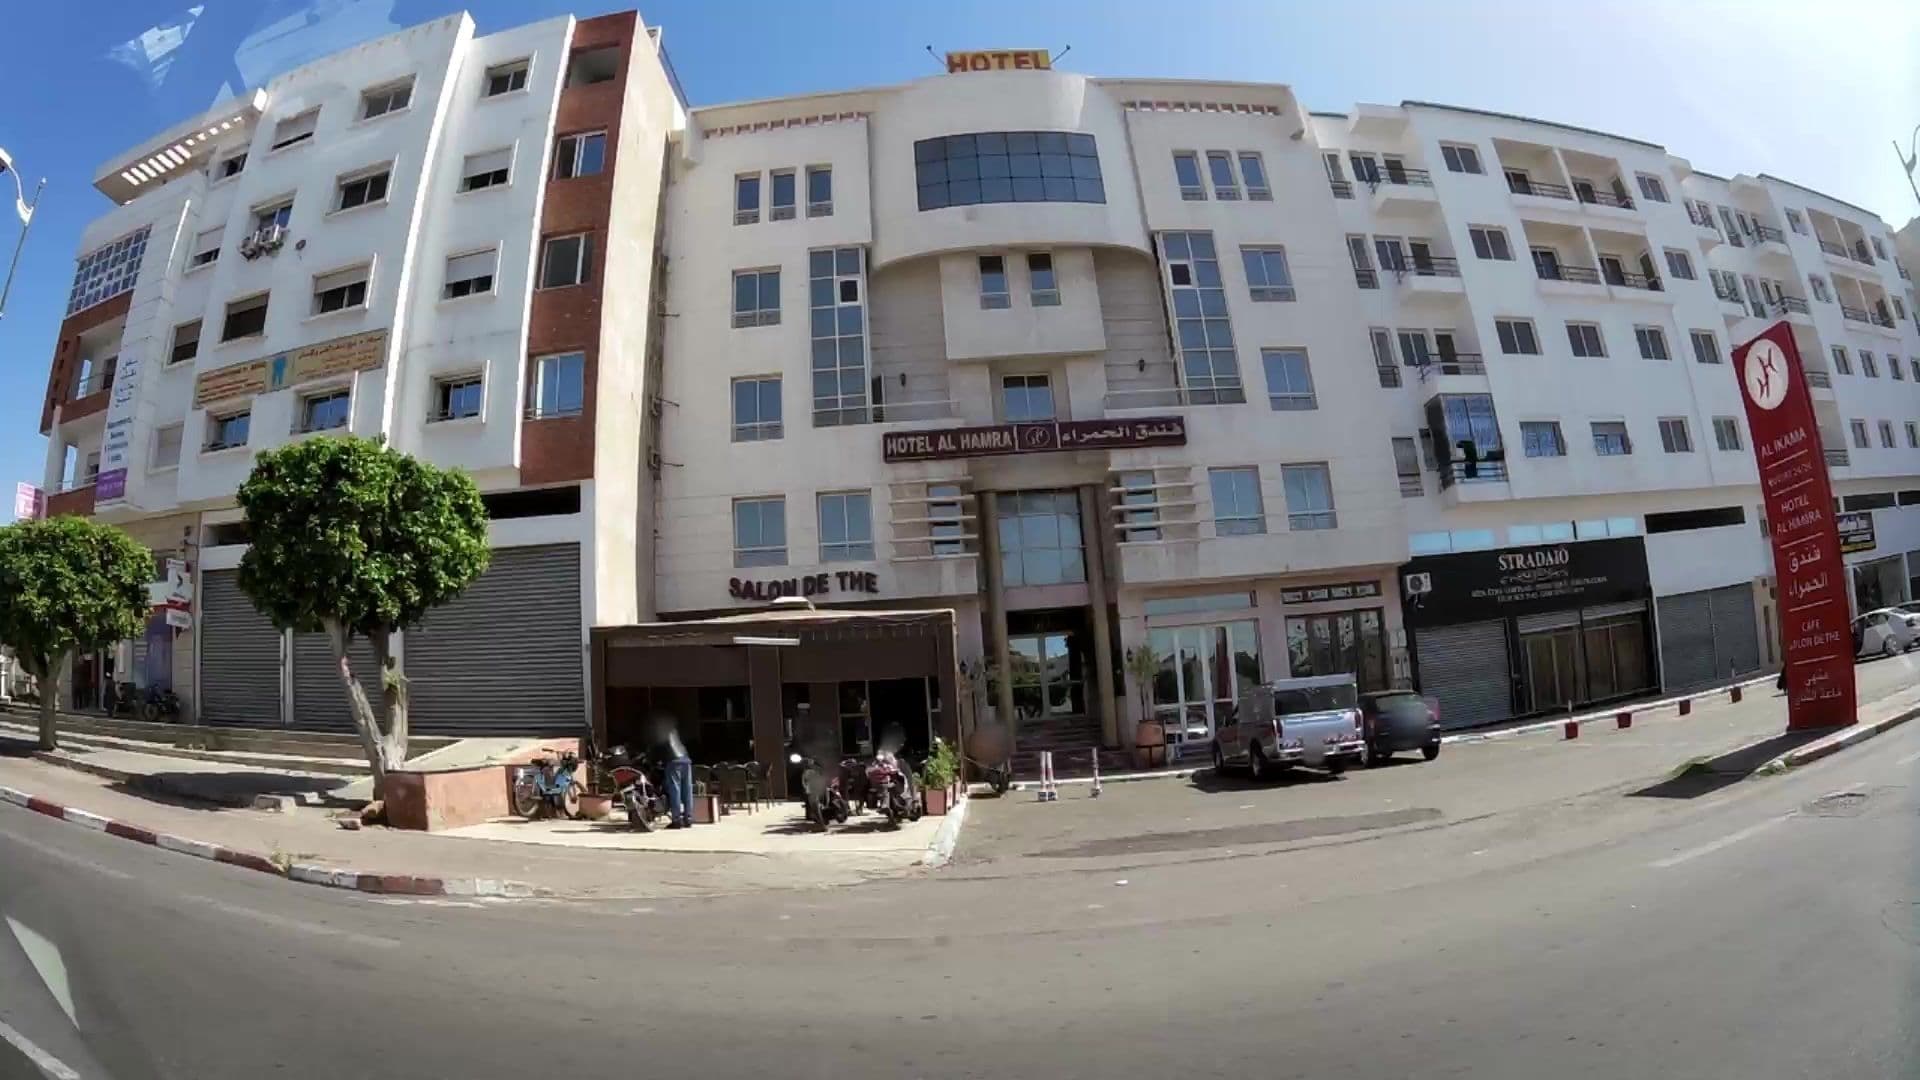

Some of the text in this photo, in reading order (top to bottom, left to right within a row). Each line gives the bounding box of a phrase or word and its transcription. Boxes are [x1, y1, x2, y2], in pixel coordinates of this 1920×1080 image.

[946, 51, 1052, 73] HOTEL
[886, 432, 1013, 455] HOTEL AL HAMRA
[1062, 421, 1184, 443] فندق الحمراء
[1761, 443, 1774, 459] AL
[1498, 548, 1569, 571] STRADAIO
[1788, 544, 1821, 573] فندق
[728, 570, 880, 601] SALON DE THE
[1788, 571, 1828, 599] الحمراء
